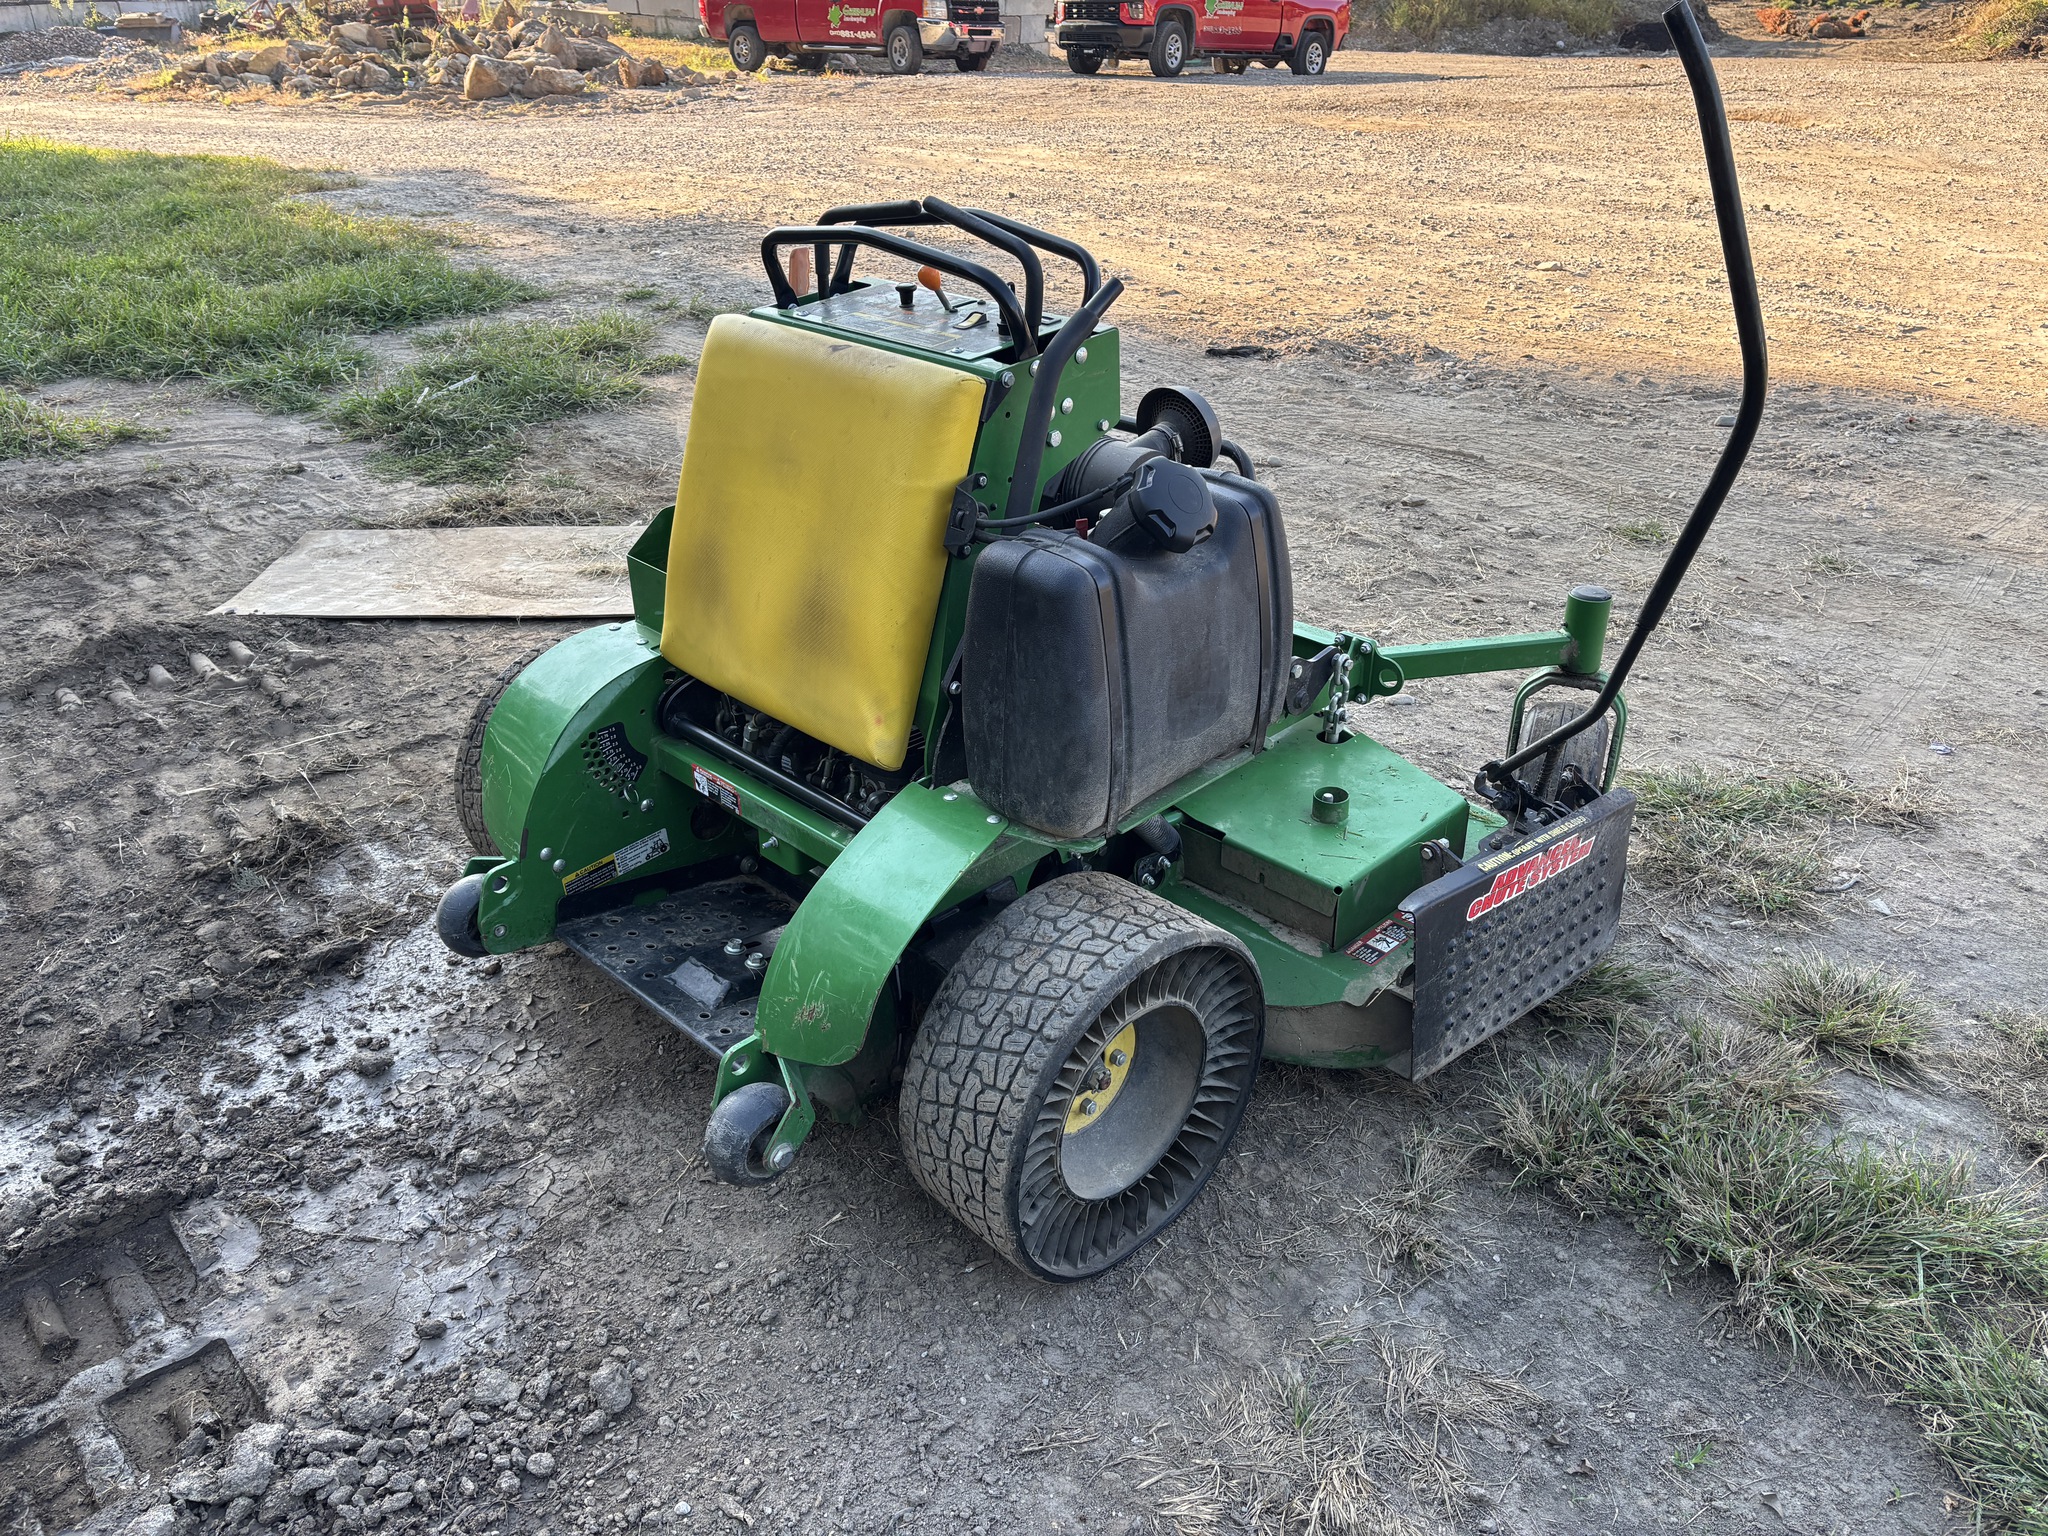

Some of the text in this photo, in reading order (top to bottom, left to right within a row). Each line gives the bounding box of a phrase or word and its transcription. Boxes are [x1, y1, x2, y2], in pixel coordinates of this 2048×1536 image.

[1491, 834, 1582, 893] ADVANCED
[1513, 840, 1539, 857] OPERATE
[1534, 832, 1551, 846] WITH
[580, 860, 604, 875] CAUTION
[1467, 839, 1594, 920] CHUTE SYSTEM
